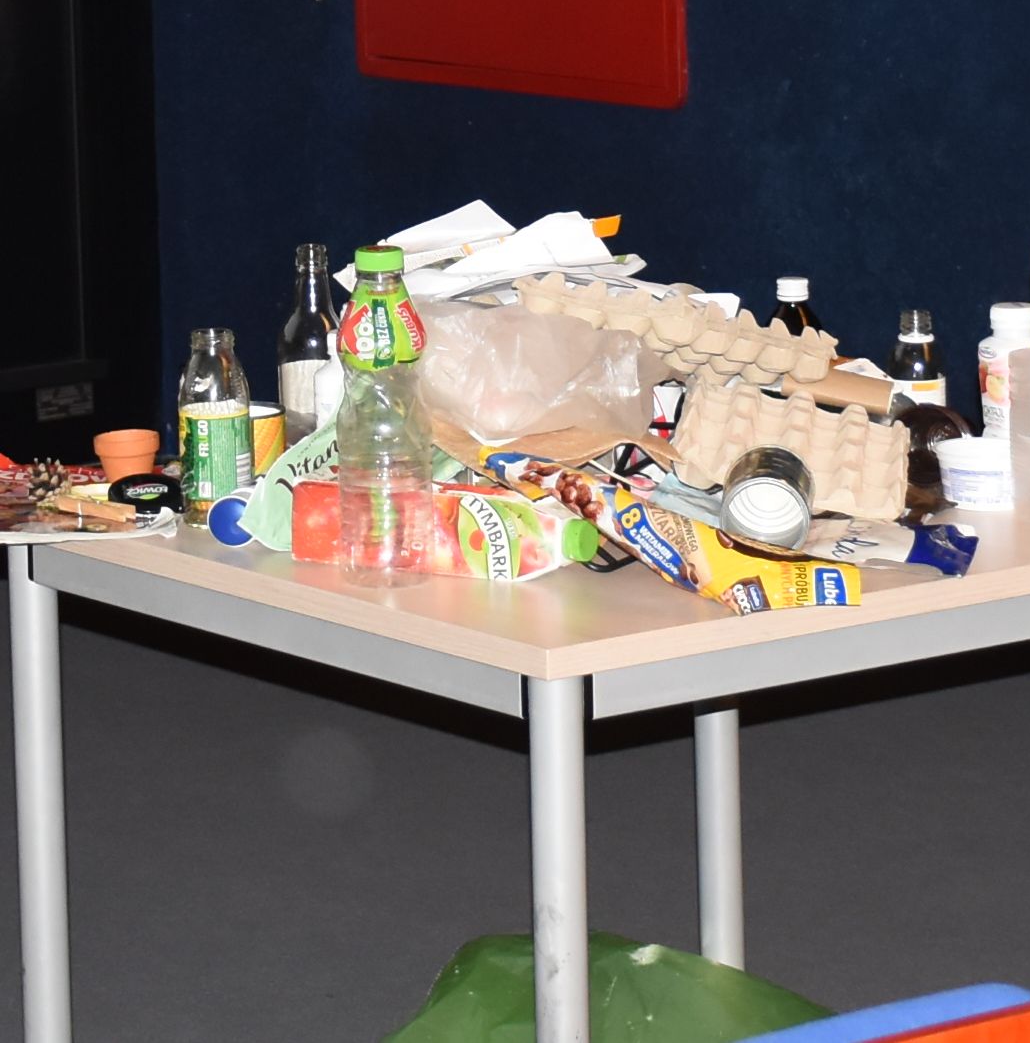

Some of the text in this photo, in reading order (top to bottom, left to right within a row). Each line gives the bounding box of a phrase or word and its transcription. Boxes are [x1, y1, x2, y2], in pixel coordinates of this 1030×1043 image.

[356, 311, 375, 360] 100%
[376, 328, 391, 346] BEZ
[197, 420, 209, 457] FRUGO
[275, 439, 340, 494] Vitan
[621, 508, 641, 529] 8
[468, 497, 508, 580] TYMBARK
[639, 525, 673, 560] WITAMIN
